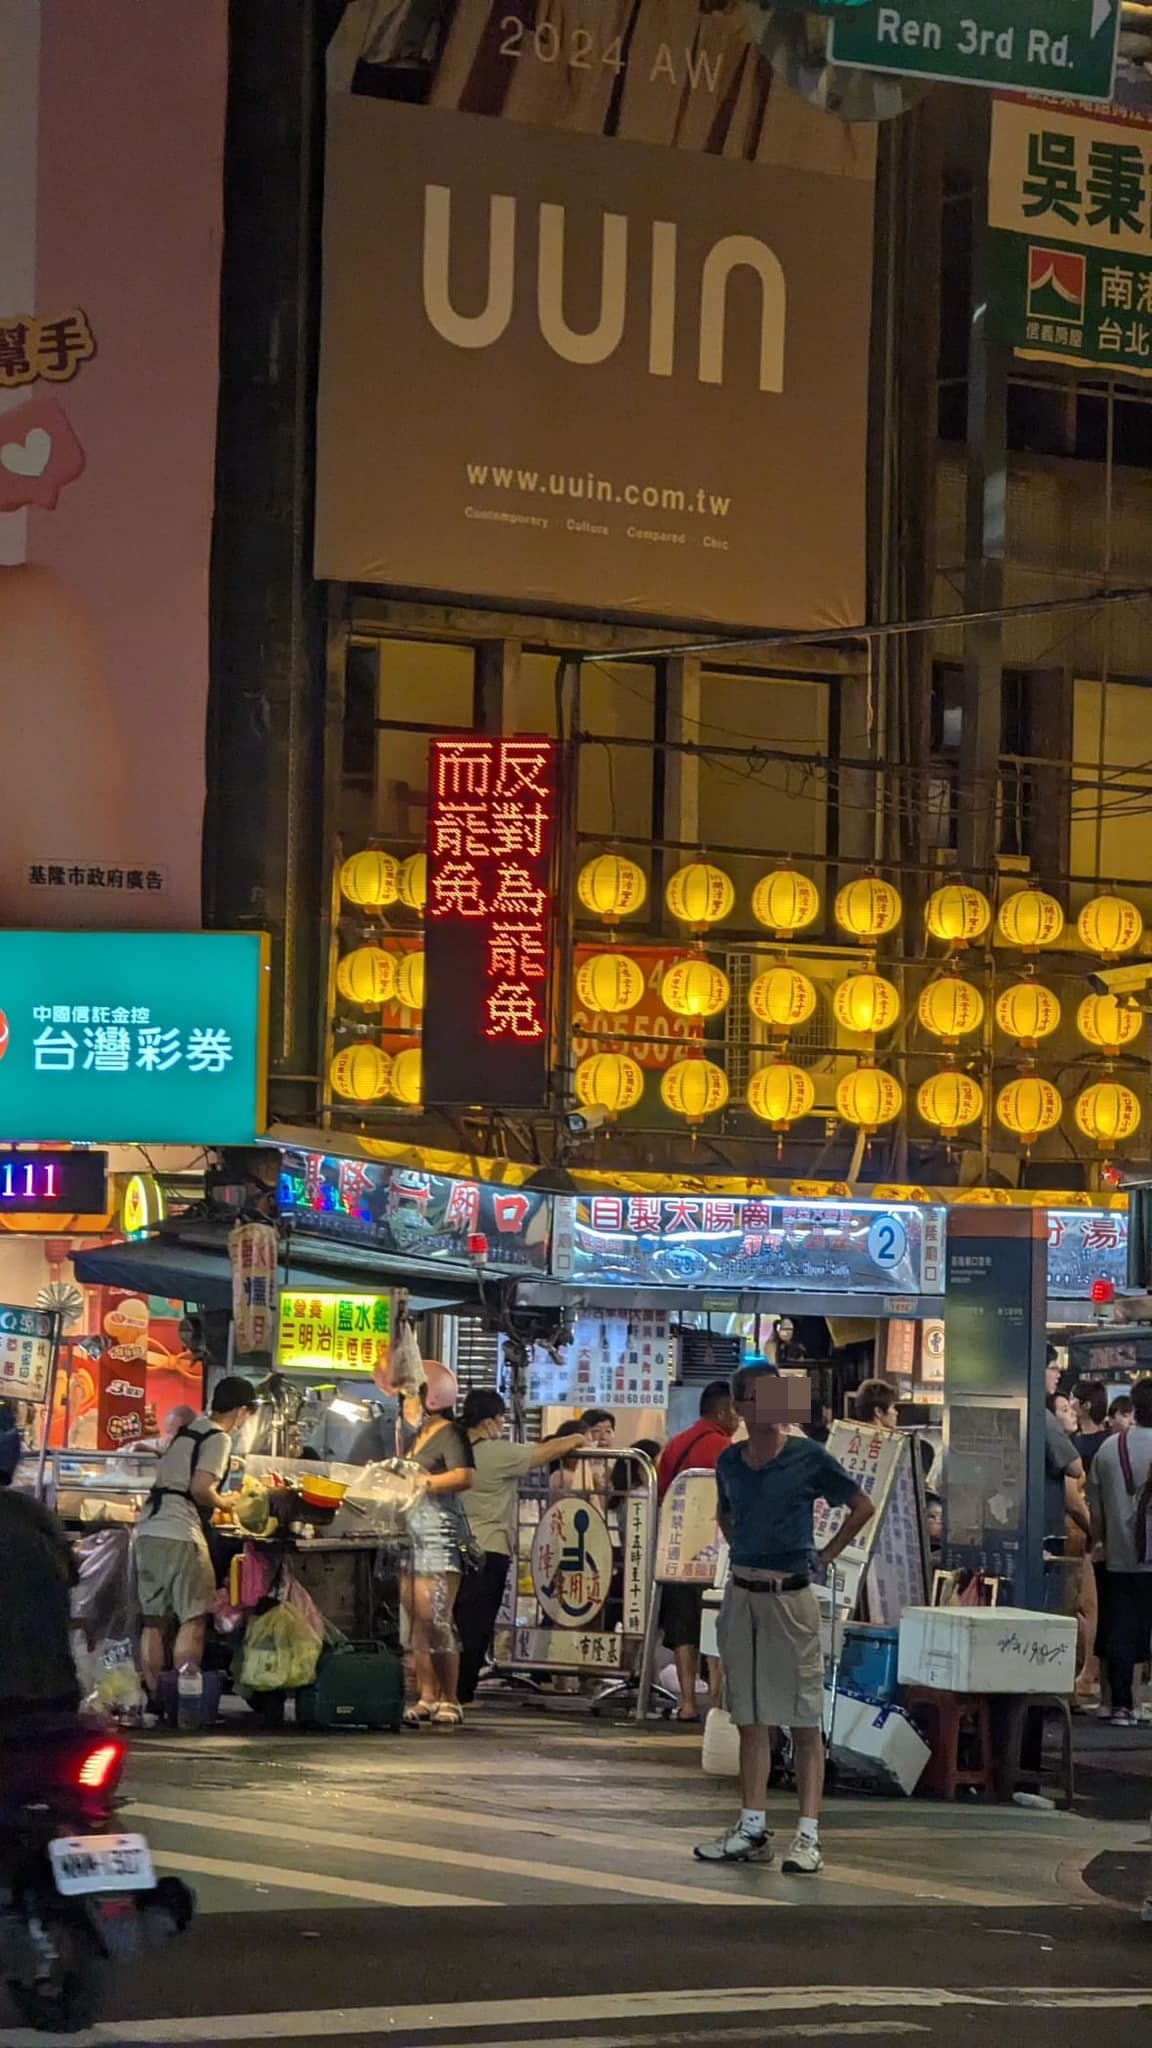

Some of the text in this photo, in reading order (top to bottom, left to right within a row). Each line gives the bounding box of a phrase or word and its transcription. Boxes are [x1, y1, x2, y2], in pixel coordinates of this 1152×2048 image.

[500, 15, 723, 92] 2024 AW
[877, 7, 1074, 69] Ren 3rd Rd.
[1021, 131, 1152, 238] 吳秉
[466, 463, 731, 517] www.uuin.com.tw
[28, 865, 163, 889] 基隆市政府廣告
[32, 1005, 151, 1024] 中國信託金控
[32, 1026, 233, 1071] 台灣彩券
[878, 1226, 896, 1260] 2
[281, 1322, 332, 1351] 三明治
